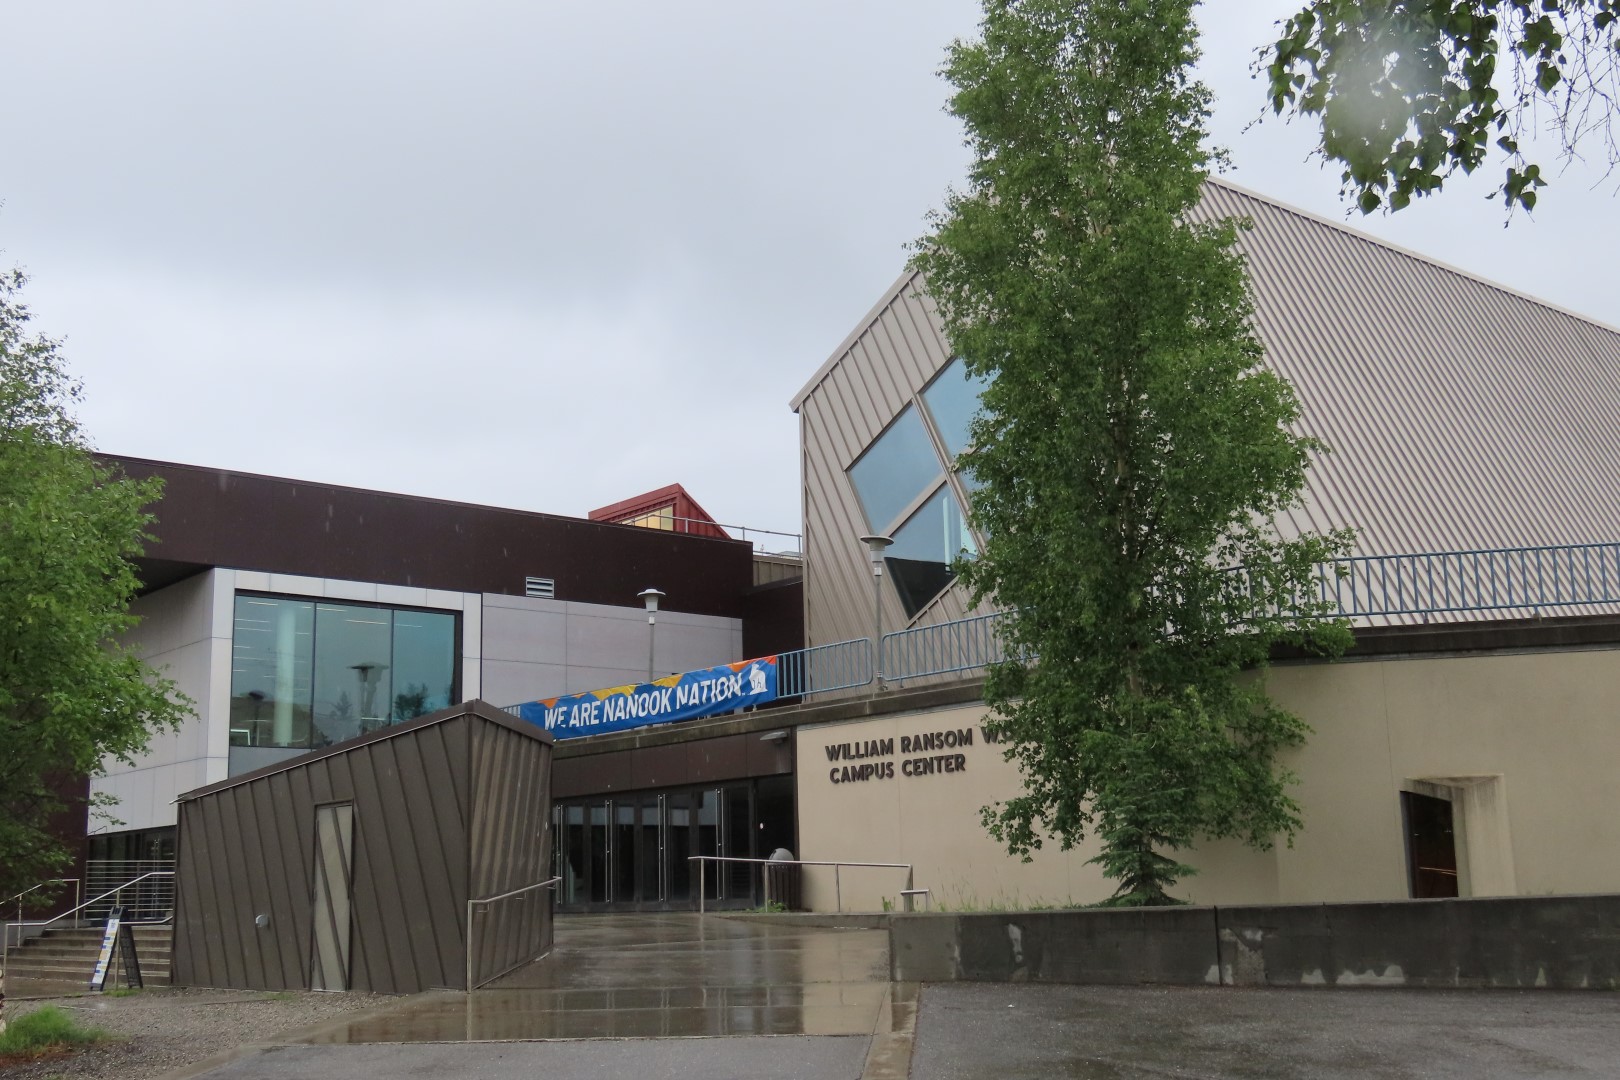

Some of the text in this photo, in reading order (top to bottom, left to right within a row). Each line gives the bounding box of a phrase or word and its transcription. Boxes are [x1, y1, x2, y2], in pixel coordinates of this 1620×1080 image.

[544, 673, 742, 730] WE ARE NANOOK NATION
[825, 738, 894, 762] WILLIAM
[900, 729, 973, 753] RANSOM
[830, 754, 966, 784] CAMPUS CENTER
